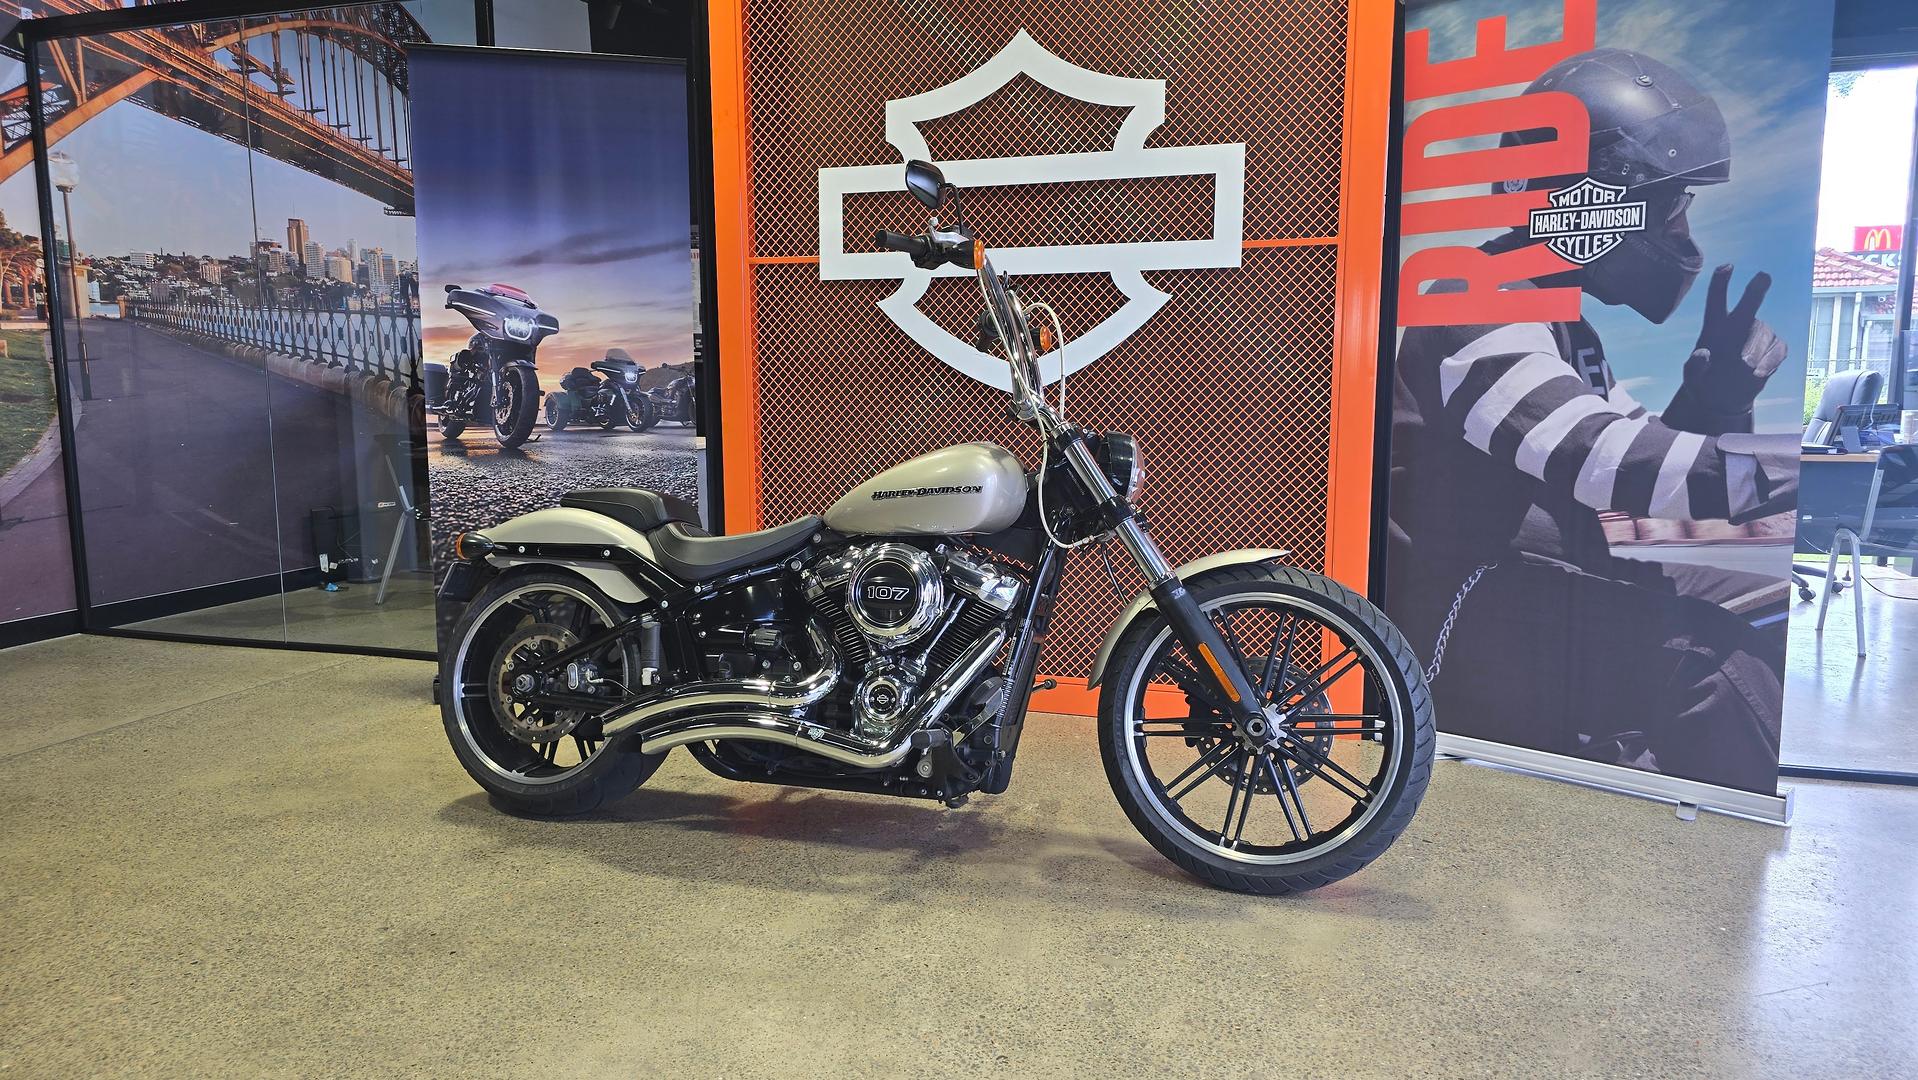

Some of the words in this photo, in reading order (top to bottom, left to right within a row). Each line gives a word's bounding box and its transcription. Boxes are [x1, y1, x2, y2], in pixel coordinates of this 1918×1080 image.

[1397, 0, 1597, 327] RIDE
[1558, 183, 1616, 207] MOTOR
[1534, 207, 1641, 233] HARLEY-DAVIDSON
[1556, 233, 1614, 259] CYCLES
[867, 585, 910, 601] 107
